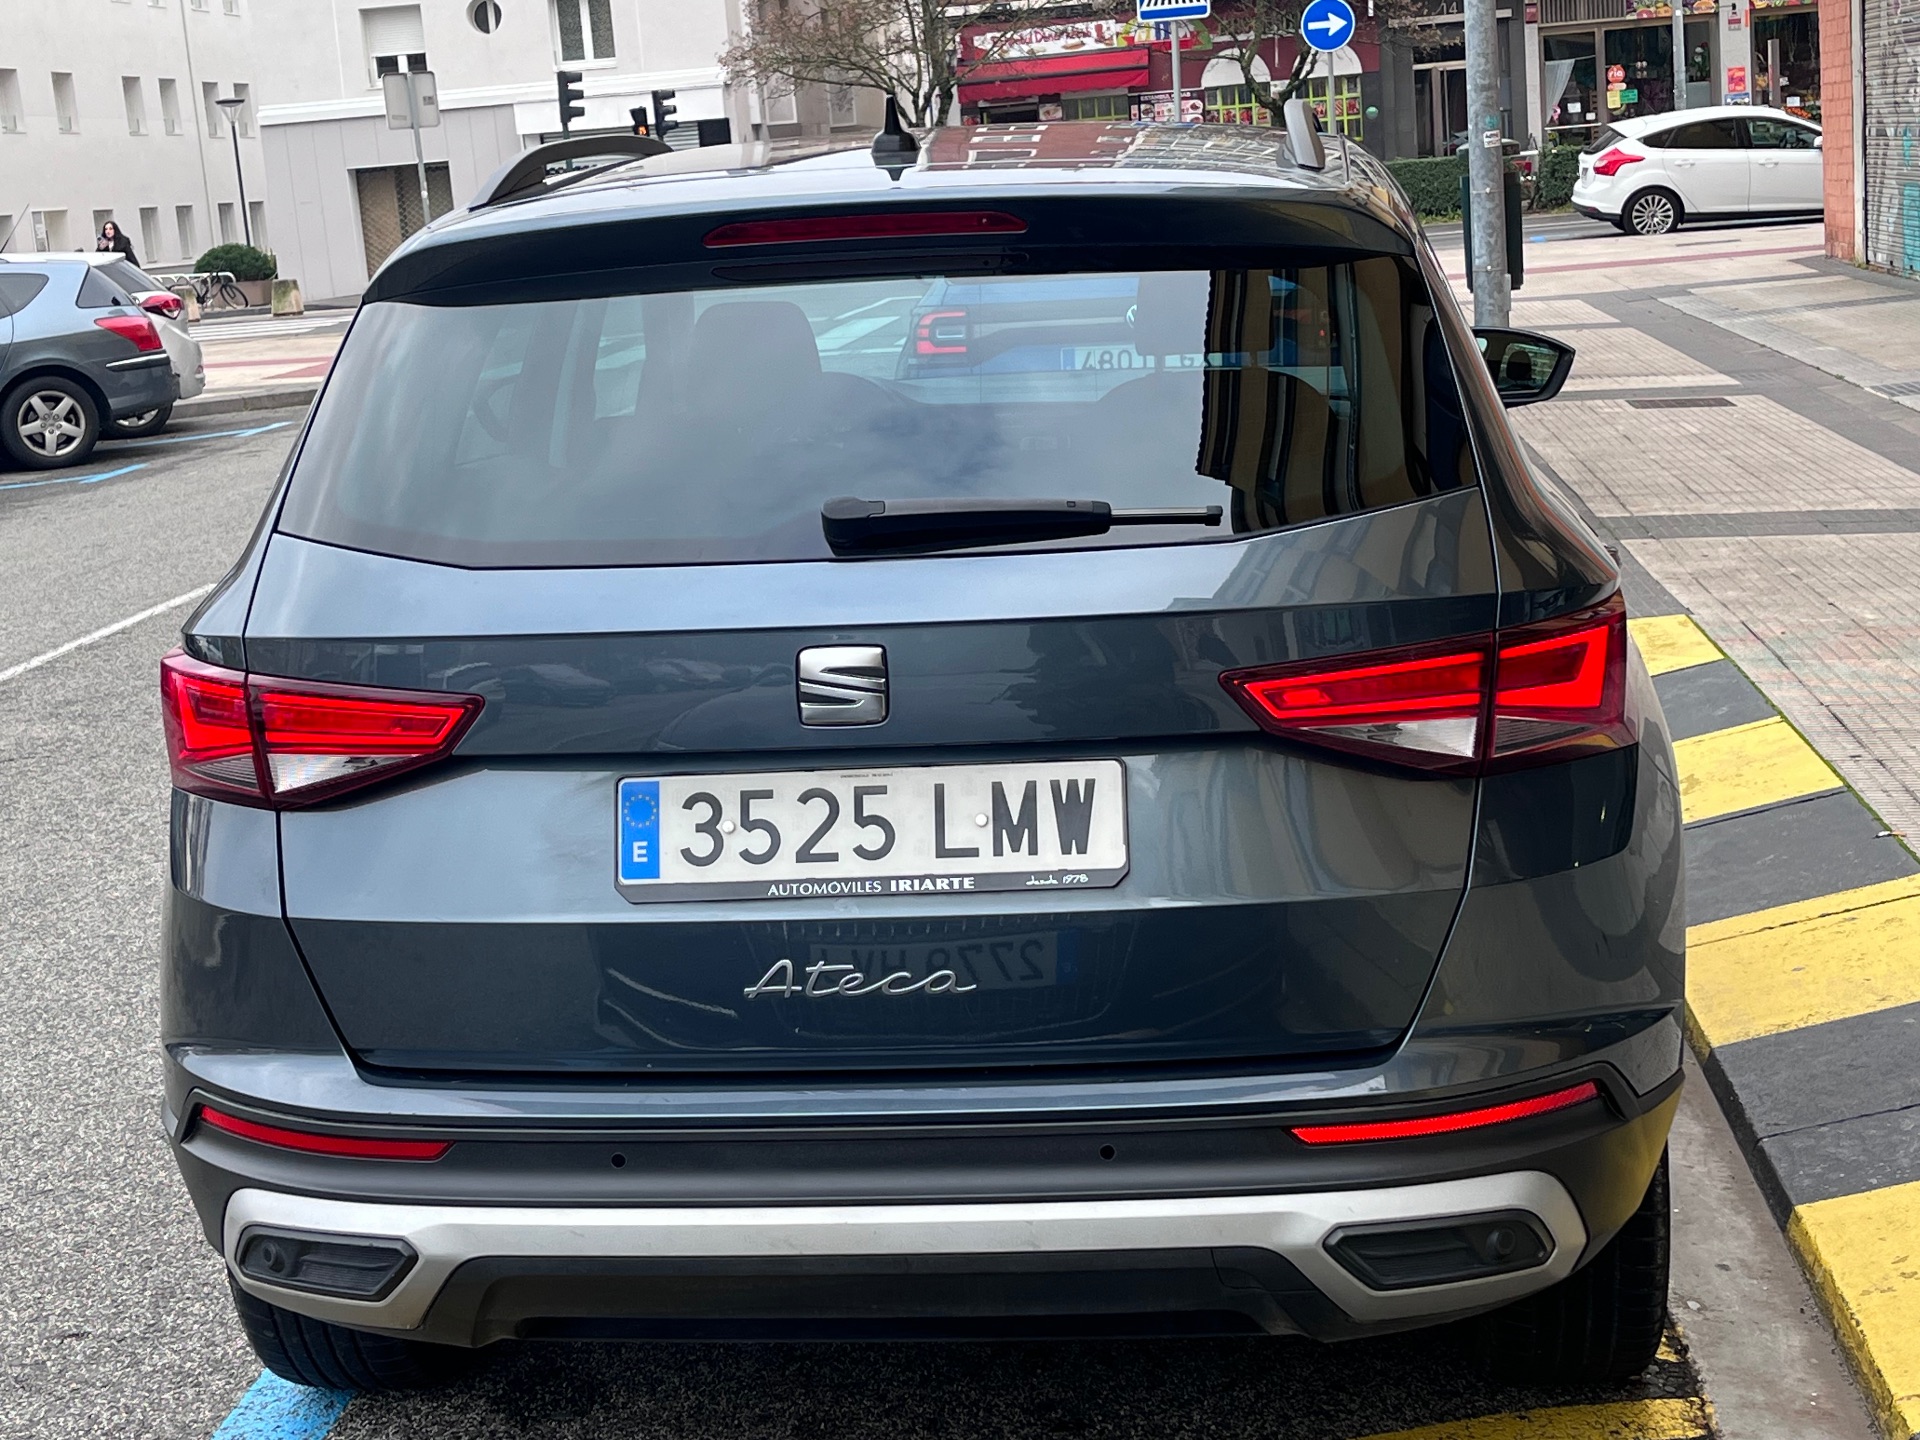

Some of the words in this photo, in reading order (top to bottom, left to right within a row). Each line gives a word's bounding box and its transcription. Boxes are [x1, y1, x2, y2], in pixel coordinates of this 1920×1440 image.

[680, 785, 896, 867] 3525
[934, 778, 1096, 859] LMW
[632, 840, 649, 863] E
[890, 877, 975, 892] IRIARTE
[1062, 873, 1089, 884] 1978
[743, 959, 978, 999] Ateca
